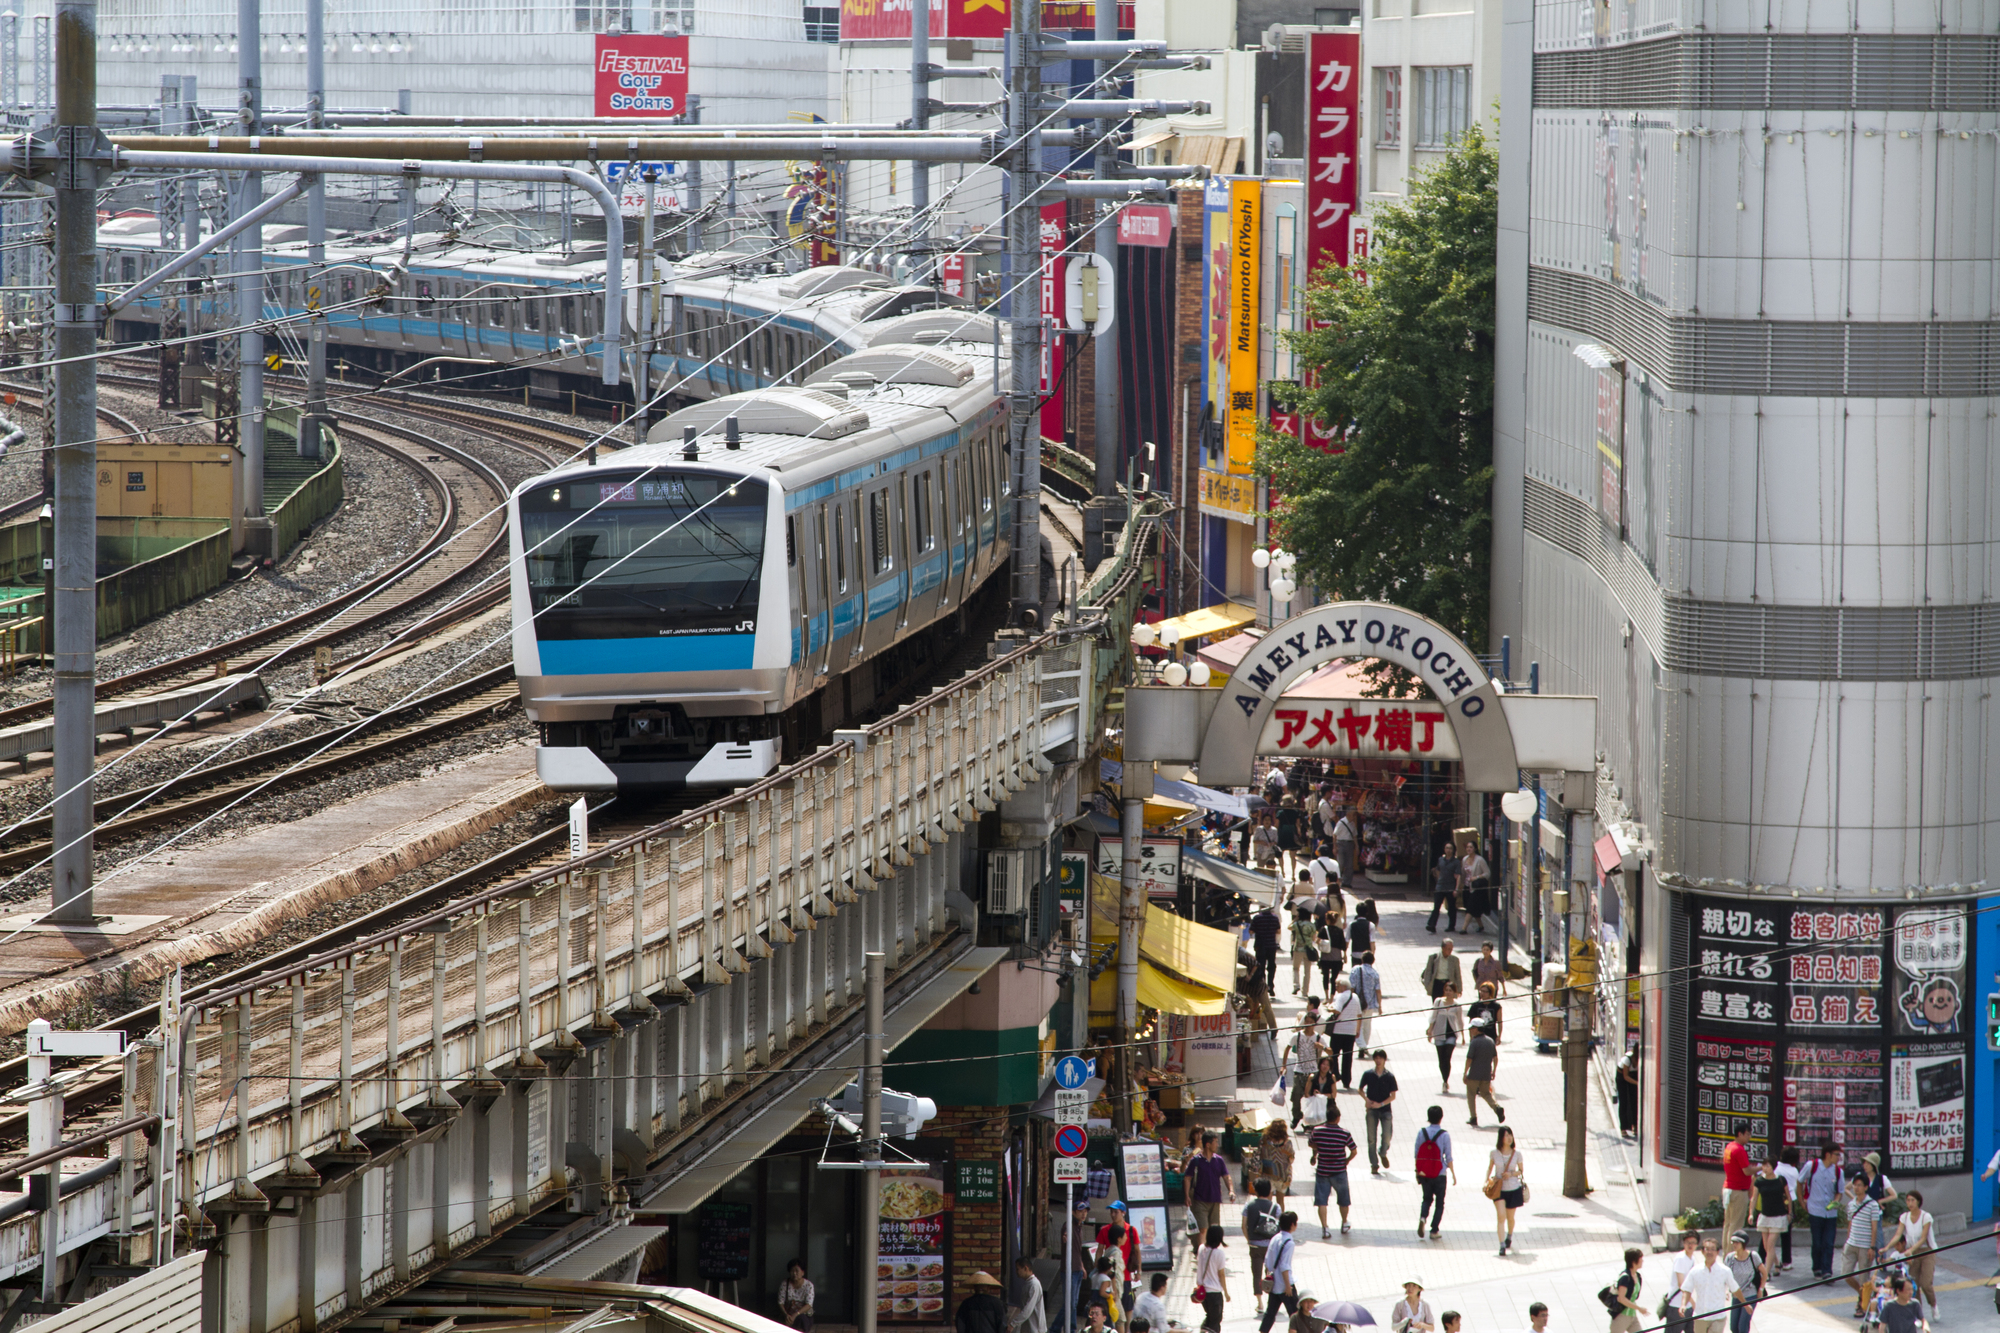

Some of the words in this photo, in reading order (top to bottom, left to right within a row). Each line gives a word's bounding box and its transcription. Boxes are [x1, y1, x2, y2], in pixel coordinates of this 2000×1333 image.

[600, 50, 685, 73] FESTIVAL
[619, 72, 661, 88] GOLF
[611, 93, 673, 110] SPORTS
[637, 87, 647, 97] &
[1313, 60, 1351, 229] カラオケ
[1238, 199, 1252, 259] KiYoshi
[1238, 260, 1251, 352] Matsumoto
[1232, 391, 1253, 411] 薬
[600, 484, 635, 501] 快速
[642, 482, 684, 496] 南浦和
[538, 577, 555, 586] 163
[735, 620, 754, 632] JR
[1235, 618, 1485, 718] AMEYAYOKOCHO
[1274, 707, 1446, 753] アメヤ横丁
[1100, 860, 1176, 876] 元寿司
[1702, 907, 1775, 936] 親切な
[1790, 912, 1883, 940] 接客応対
[1902, 920, 1962, 941] 日本一を
[1902, 941, 1962, 962] 目指します
[1701, 949, 1773, 979] 頼れる
[1790, 954, 1882, 982] 商品知識
[1700, 990, 1773, 1019] 豊富な
[1790, 995, 1880, 1023] 品揃え
[1193, 1012, 1231, 1032] 100円
[40, 1036, 53, 1053] L
[1191, 1042, 1231, 1051] 60種類以上
[1697, 1041, 1773, 1062] 配達サービス
[1909, 1043, 1928, 1052] GOLD
[1929, 1042, 1946, 1051] POINT
[1947, 1041, 1961, 1049] CARD
[1787, 1047, 1881, 1062] ヨドバシカメラ
[1699, 1089, 1769, 1113] 即日配達
[1891, 1109, 1964, 1124] ヨドバシカメラ
[1891, 1122, 1964, 1138] 以外で利用しても
[1698, 1137, 1769, 1161] 指定達
[1891, 1136, 1964, 1152] 1%ポイント還元
[1891, 1152, 1964, 1170] 新規会員募集中
[961, 1167, 972, 1175] 2F
[961, 1176, 972, 1184] 1F
[961, 1189, 976, 1197] B1F
[878, 1243, 926, 1253] ェットチーネ。
